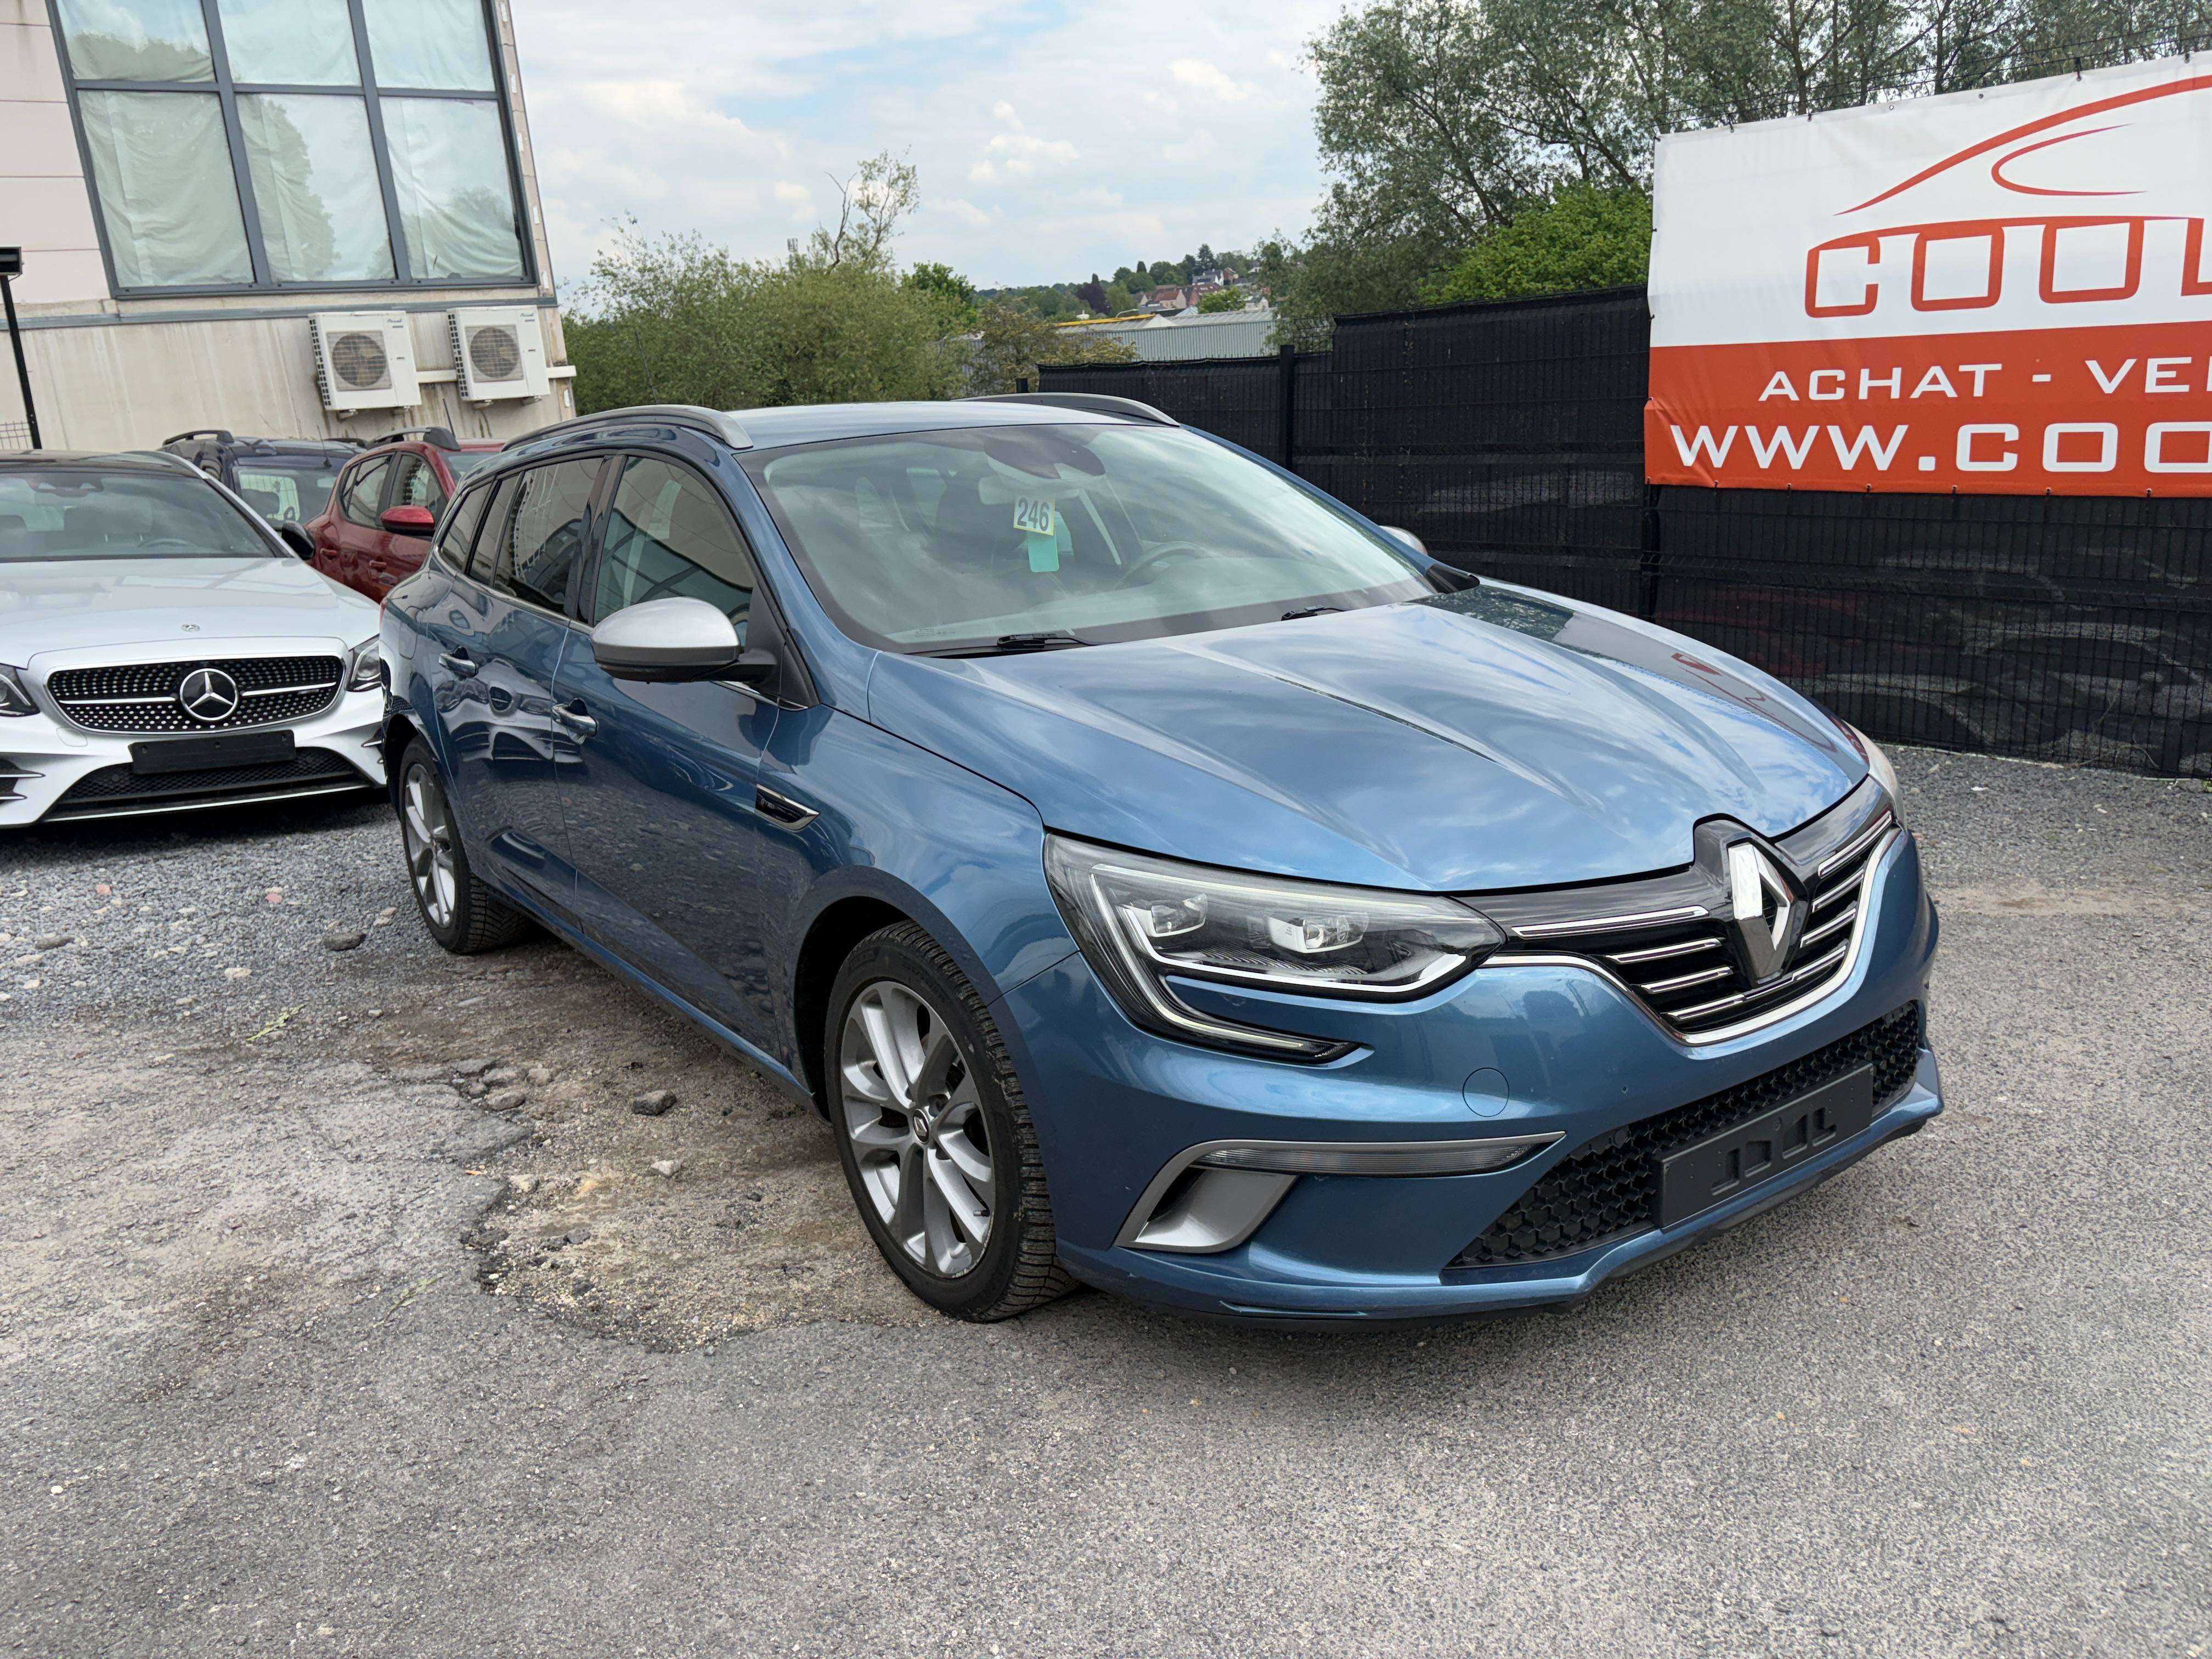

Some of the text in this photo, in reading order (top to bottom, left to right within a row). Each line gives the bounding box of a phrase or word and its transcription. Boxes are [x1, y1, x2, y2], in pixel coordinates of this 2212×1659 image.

[1759, 364, 2002, 401] ACHAT
[2085, 357, 2212, 394] VE
[1670, 422, 2212, 473] WWW.COO
[1018, 497, 1049, 531] 246
